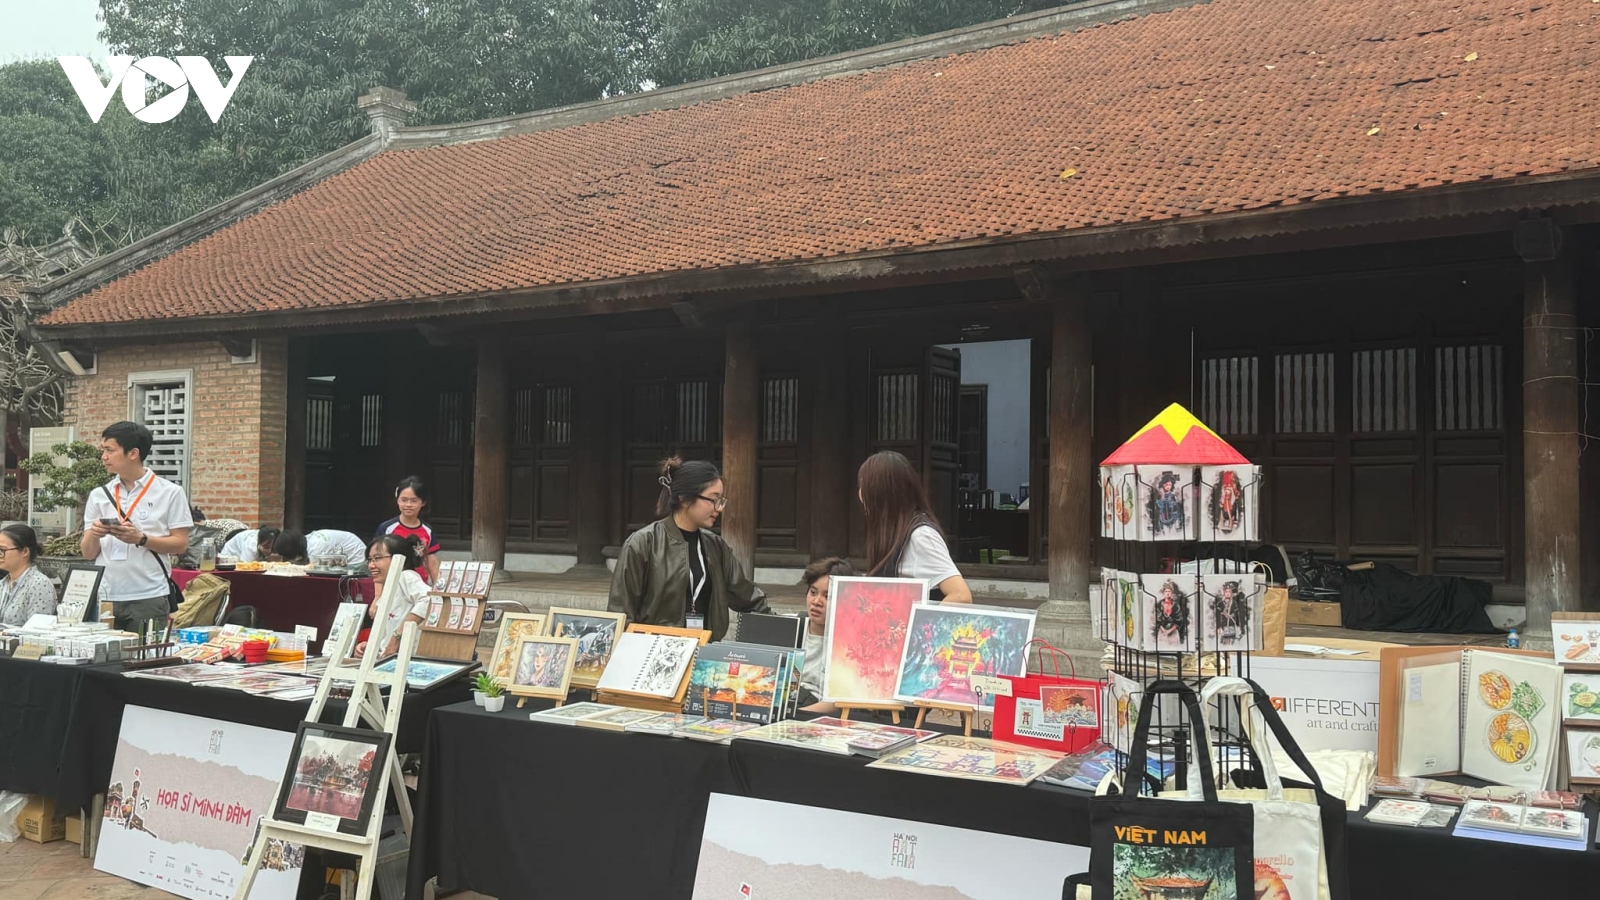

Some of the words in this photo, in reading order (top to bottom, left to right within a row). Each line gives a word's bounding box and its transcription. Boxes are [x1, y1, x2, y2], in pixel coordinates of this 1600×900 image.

[1306, 719, 1323, 729] art
[1325, 718, 1348, 731] and
[1164, 831, 1206, 844] NAM
